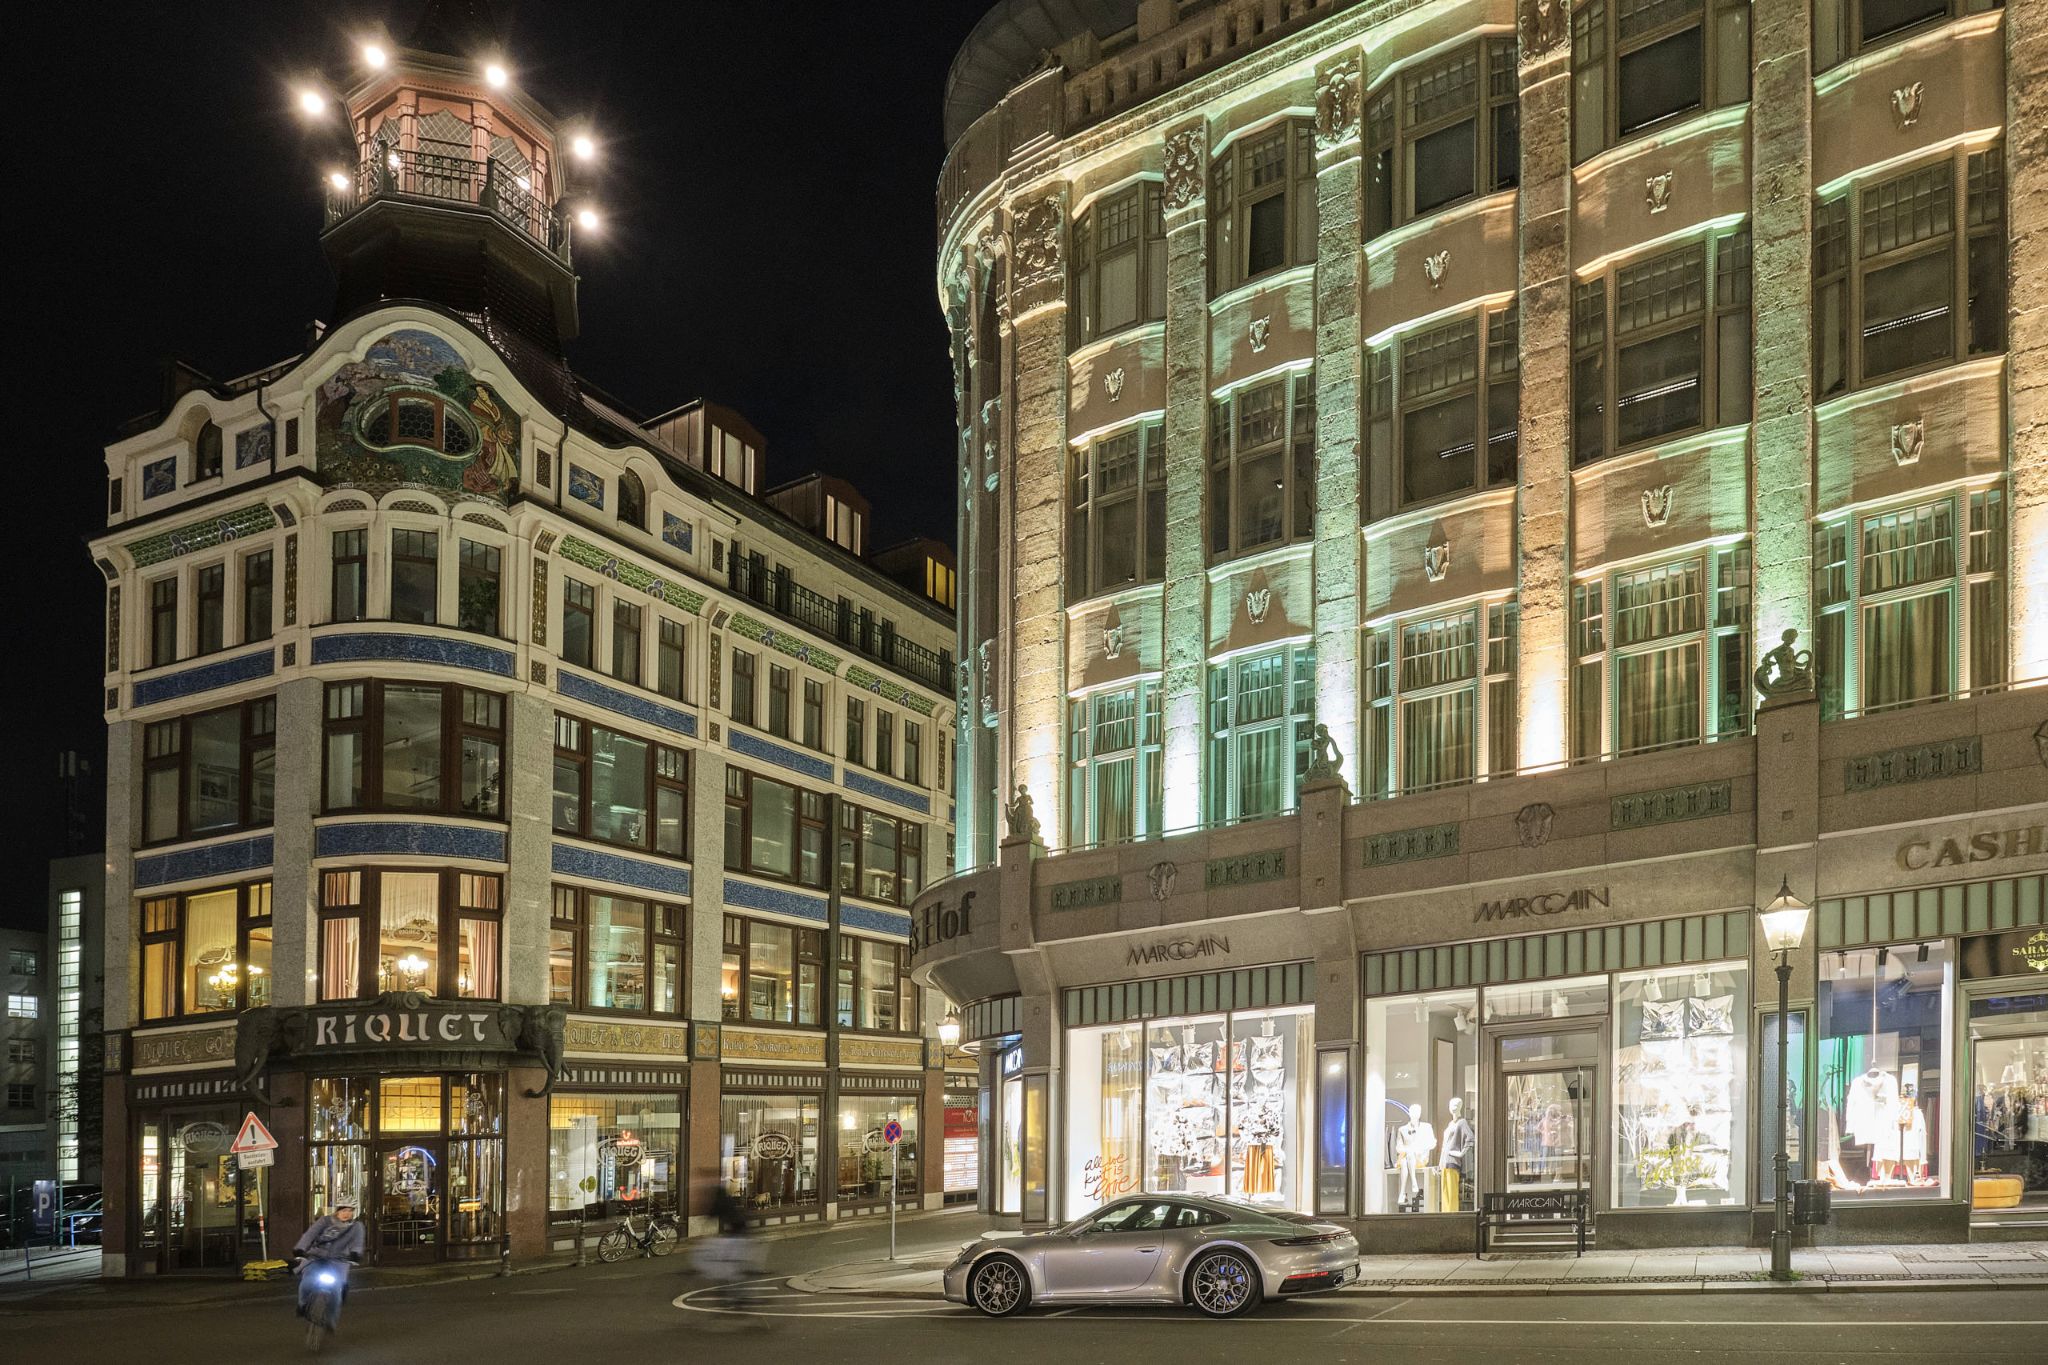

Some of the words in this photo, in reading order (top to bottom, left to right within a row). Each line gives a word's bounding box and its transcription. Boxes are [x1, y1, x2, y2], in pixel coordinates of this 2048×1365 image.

[1896, 825, 2048, 871] CASH
[920, 891, 976, 949] Hof
[315, 1013, 489, 1046] RIQUET
[1084, 1155, 1103, 1171] all
[1113, 1165, 1124, 1176] is
[38, 1192, 51, 1218] P
